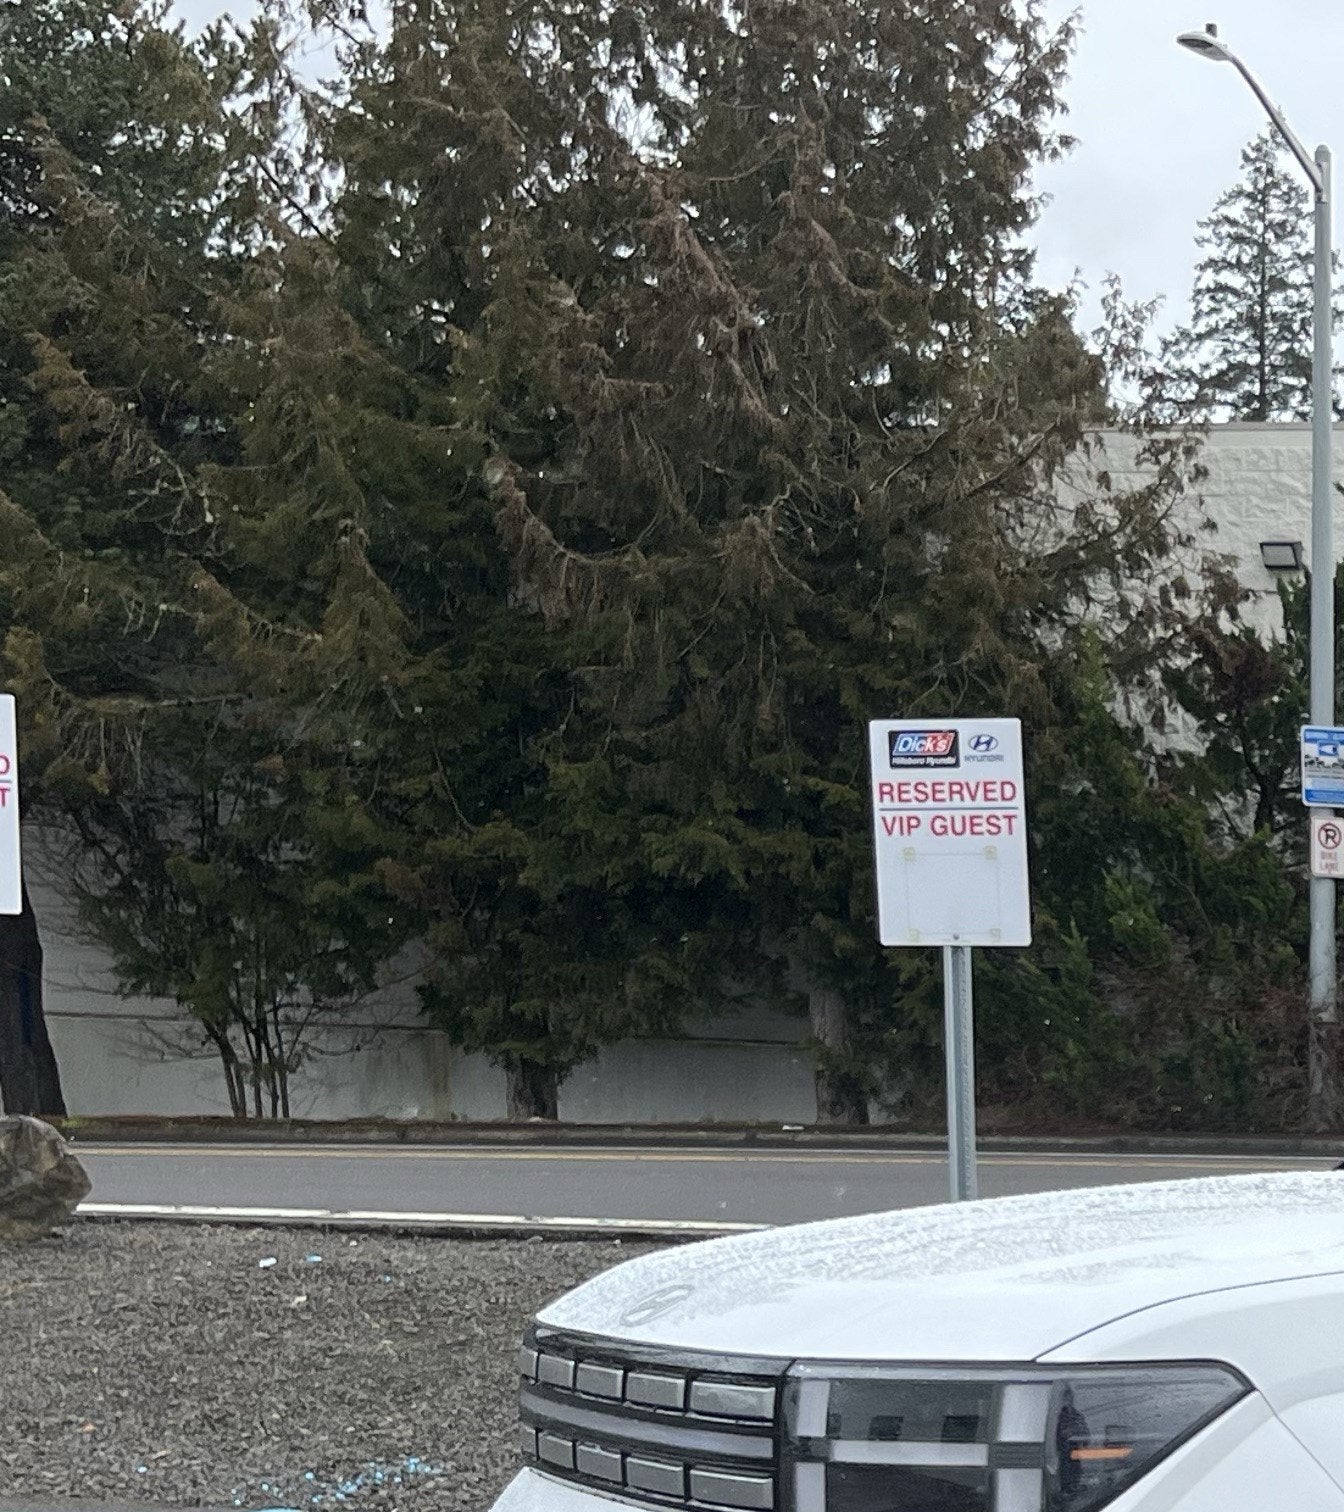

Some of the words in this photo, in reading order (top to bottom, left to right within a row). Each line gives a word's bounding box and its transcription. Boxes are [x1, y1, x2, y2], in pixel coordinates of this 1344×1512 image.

[878, 781, 1017, 803] RESERVED
[881, 815, 922, 837] VIP
[930, 814, 1018, 836] GUEST
